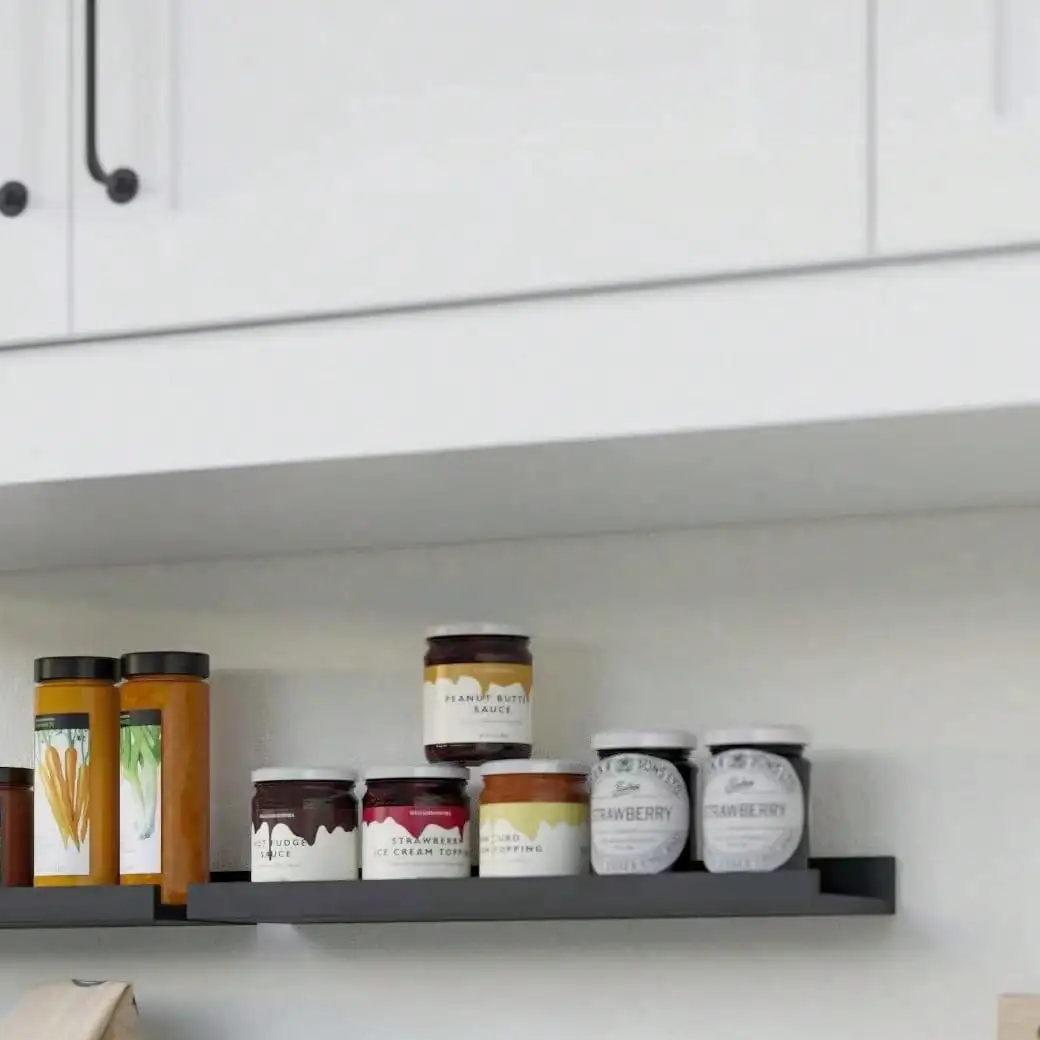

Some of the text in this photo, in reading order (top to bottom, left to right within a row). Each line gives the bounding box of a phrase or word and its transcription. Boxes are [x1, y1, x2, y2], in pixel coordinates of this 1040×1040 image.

[445, 694, 491, 703] PEANUT
[473, 705, 511, 714] SAUCE
[592, 805, 673, 822] TRAWBERRY
[705, 802, 786, 818] TRAWBERRY
[393, 848, 433, 857] CREAM
